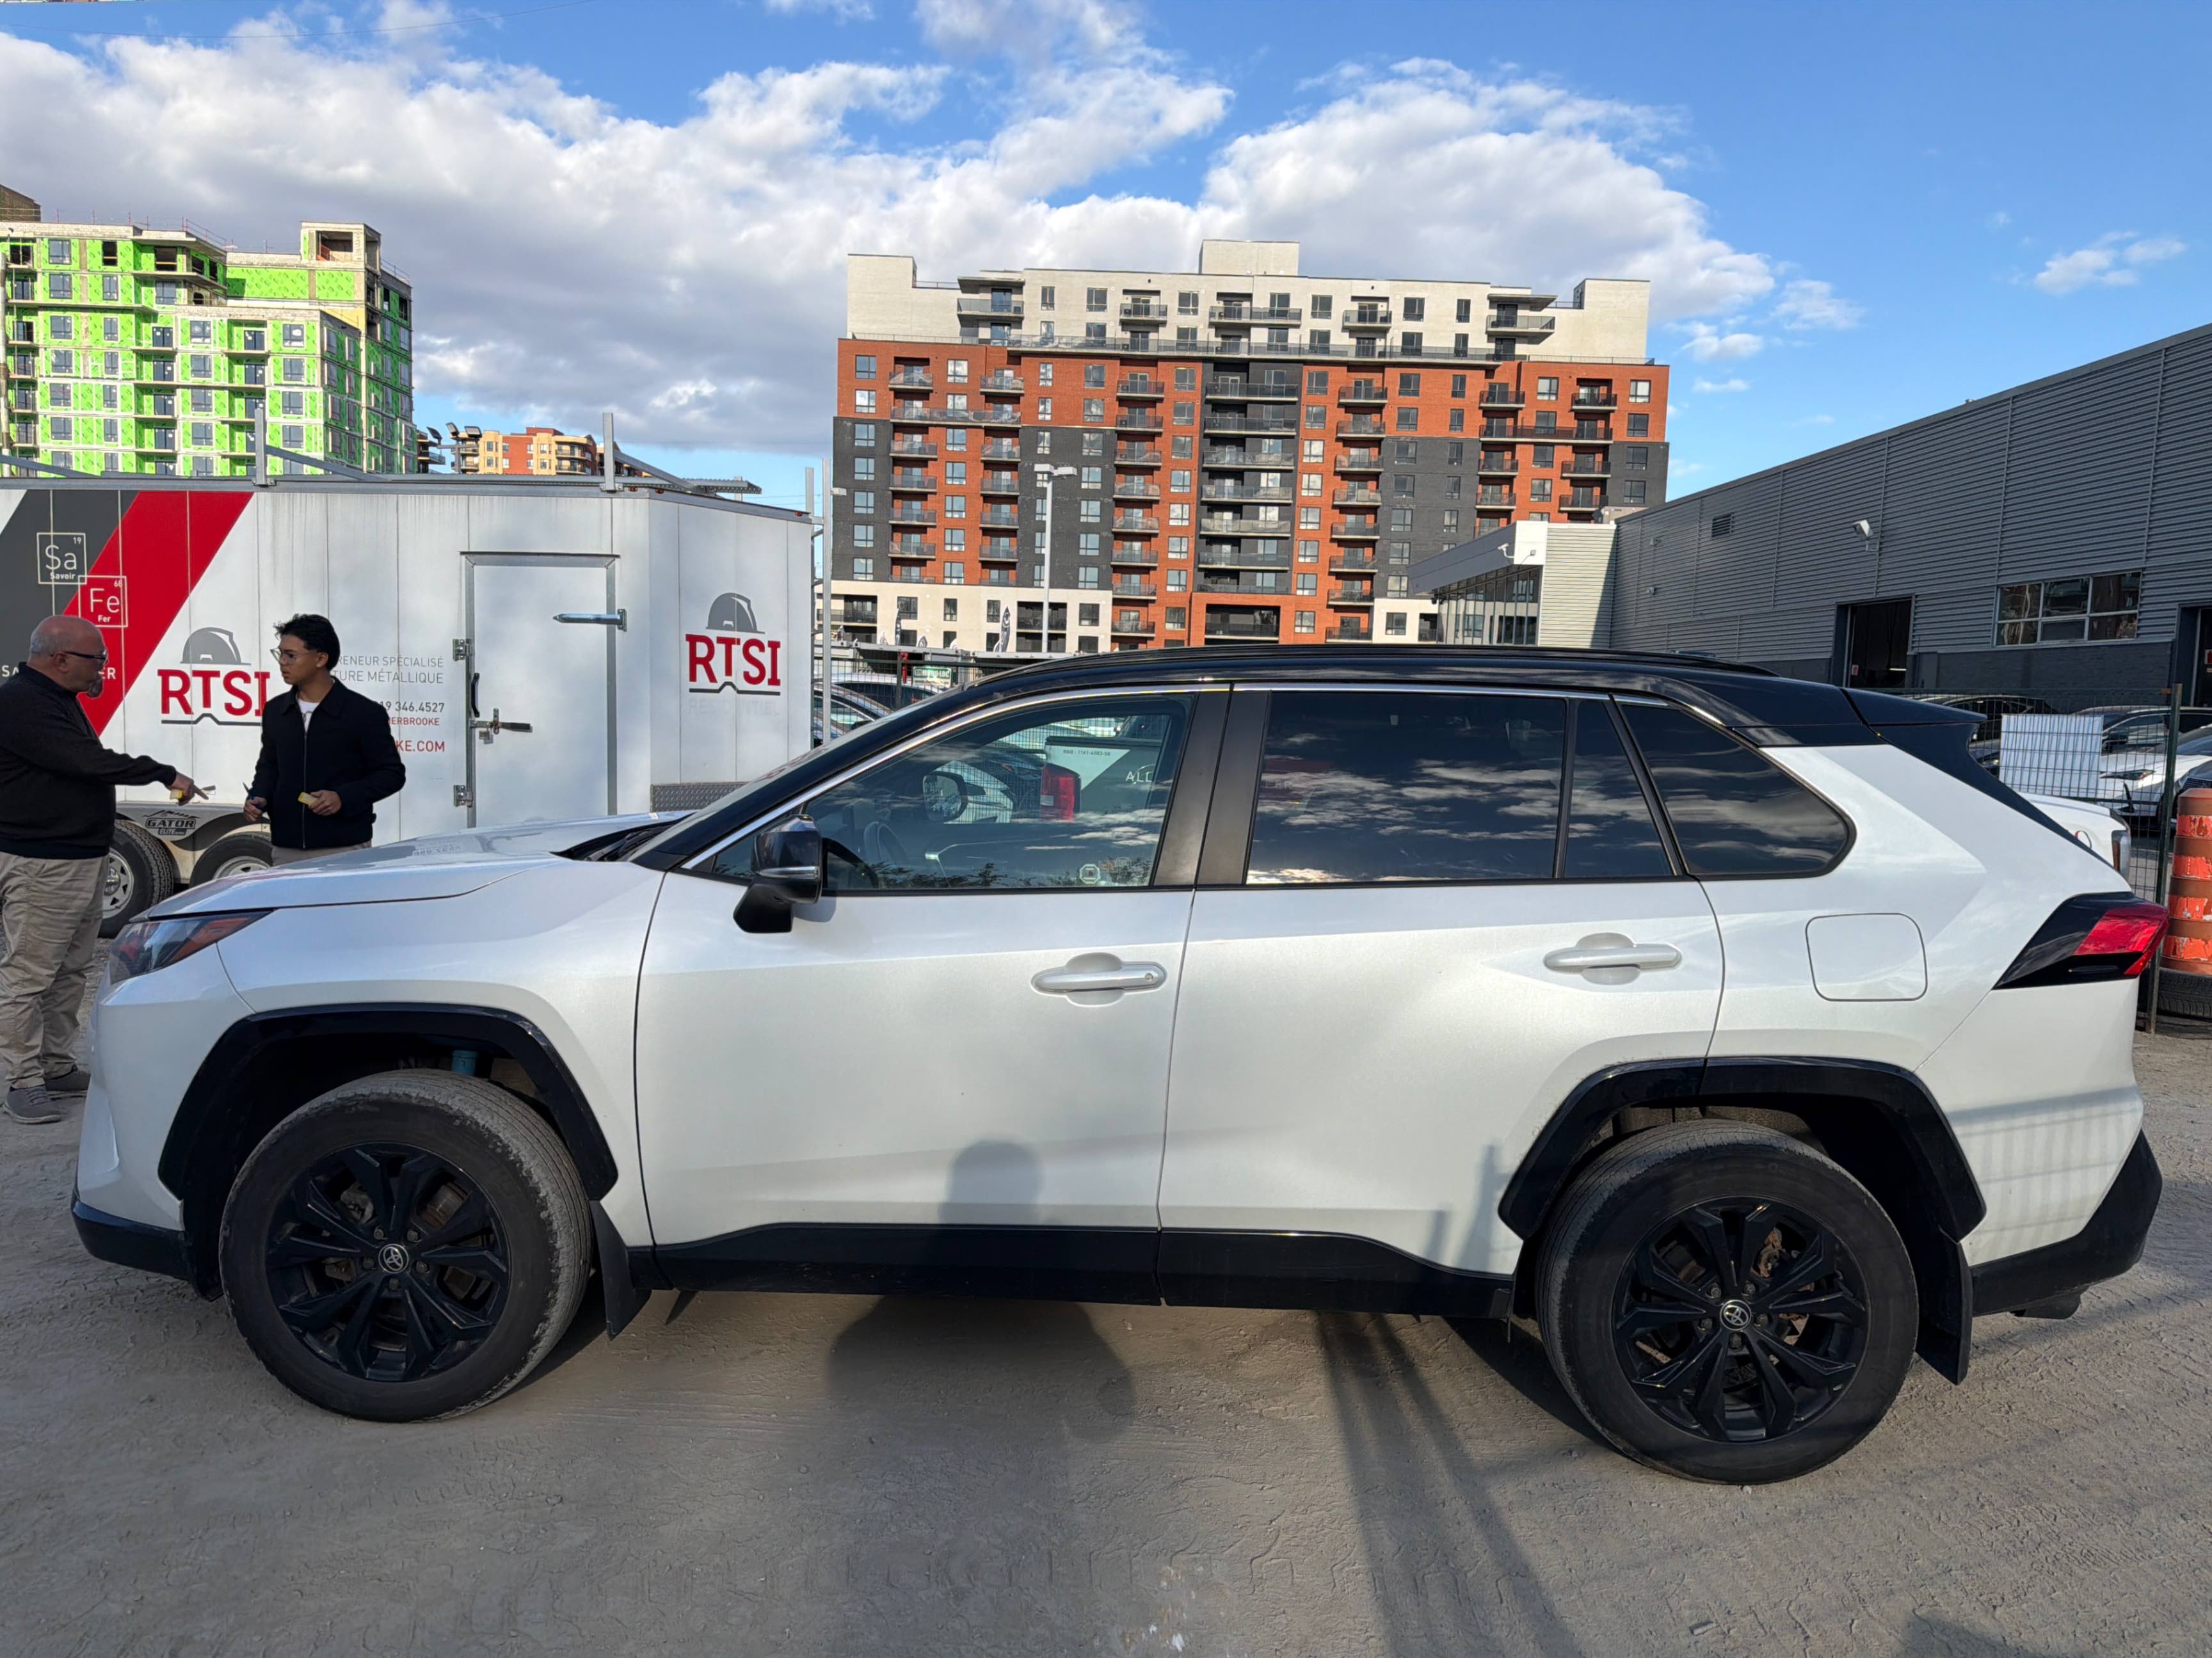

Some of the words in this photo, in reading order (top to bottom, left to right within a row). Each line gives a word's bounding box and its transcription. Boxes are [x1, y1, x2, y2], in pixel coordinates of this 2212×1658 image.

[45, 545, 77, 570] Sa
[90, 587, 120, 613] Fe
[339, 655, 380, 666] RENEUR
[383, 655, 444, 668] SPÉCIALISÉ
[685, 634, 781, 687] RTSI
[330, 669, 364, 682] TURE
[367, 668, 444, 684] MÉTALLIQUE
[157, 669, 271, 717] RTSI
[395, 701, 445, 713] 346.4527
[396, 740, 445, 753] KE.COM
[1125, 770, 1153, 783] ALL
[147, 819, 195, 828] GATOR
